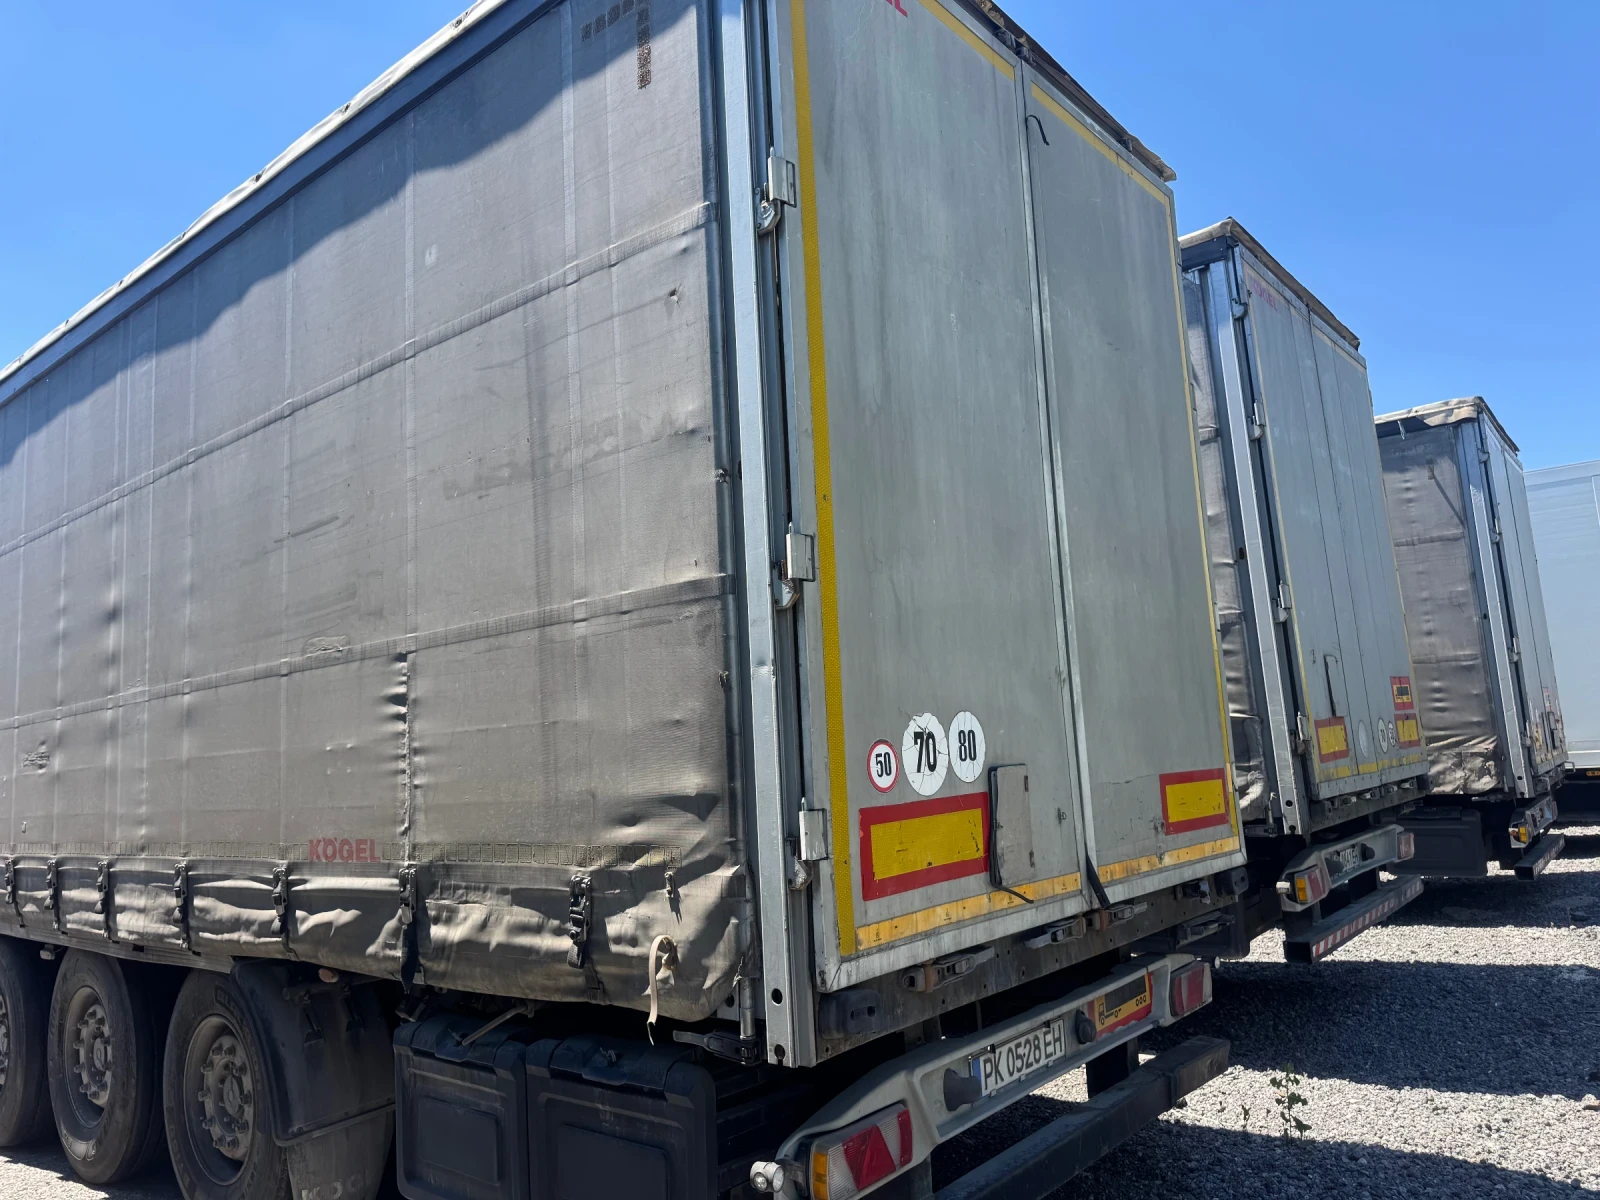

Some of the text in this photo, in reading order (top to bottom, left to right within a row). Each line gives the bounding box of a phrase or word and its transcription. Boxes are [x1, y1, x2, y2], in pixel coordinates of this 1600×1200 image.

[913, 731, 937, 773] 70
[958, 729, 977, 762] 80
[875, 751, 892, 777] 50
[308, 837, 381, 863] KÖGEL
[982, 1023, 1063, 1091] PK 0528 EH
